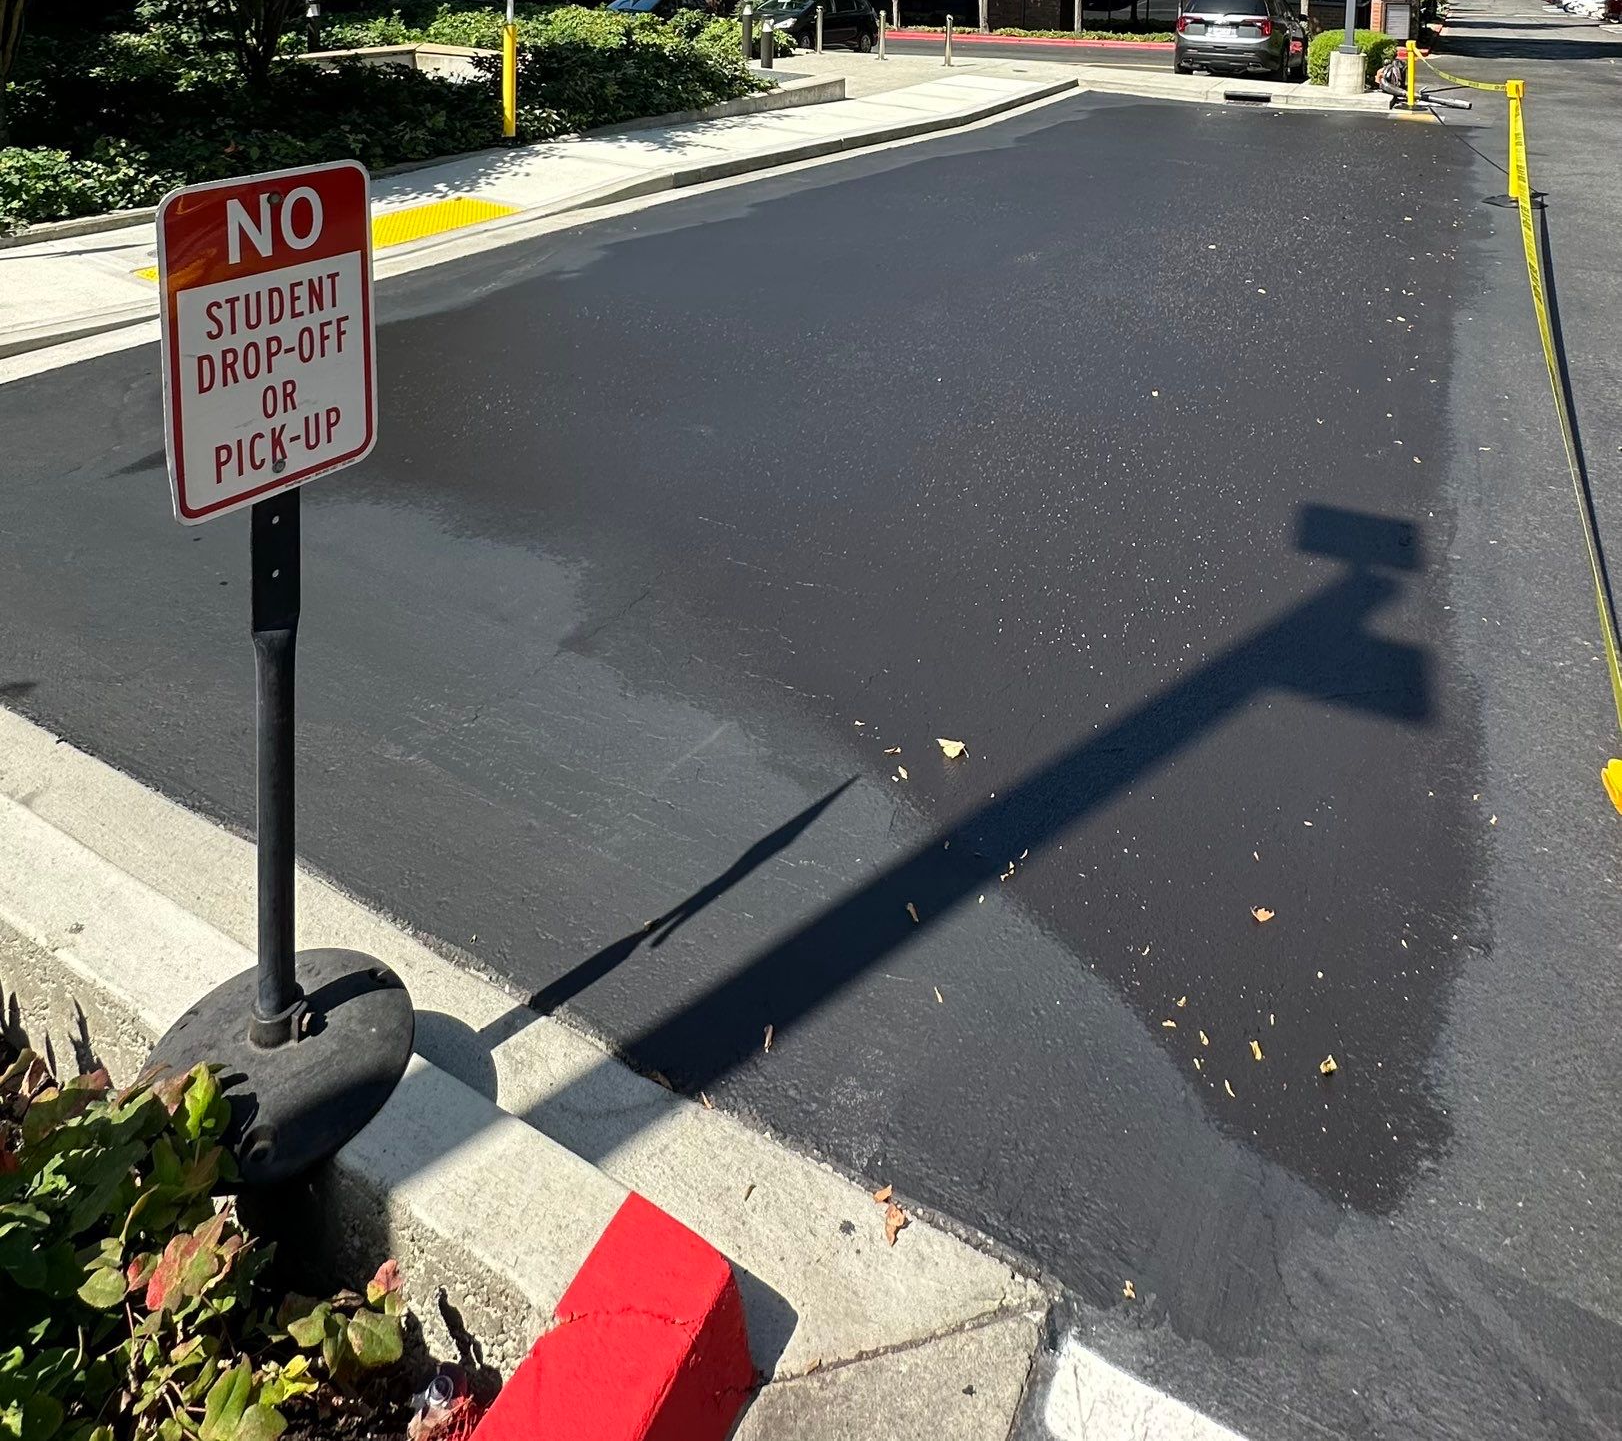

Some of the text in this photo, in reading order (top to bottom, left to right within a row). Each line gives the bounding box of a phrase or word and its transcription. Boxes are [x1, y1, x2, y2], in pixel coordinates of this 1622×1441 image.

[226, 186, 323, 265] NO
[205, 272, 340, 340] STUDENT
[197, 315, 349, 394] DROP-OFF
[262, 379, 297, 419] OR
[215, 406, 341, 485] PICK-UP
